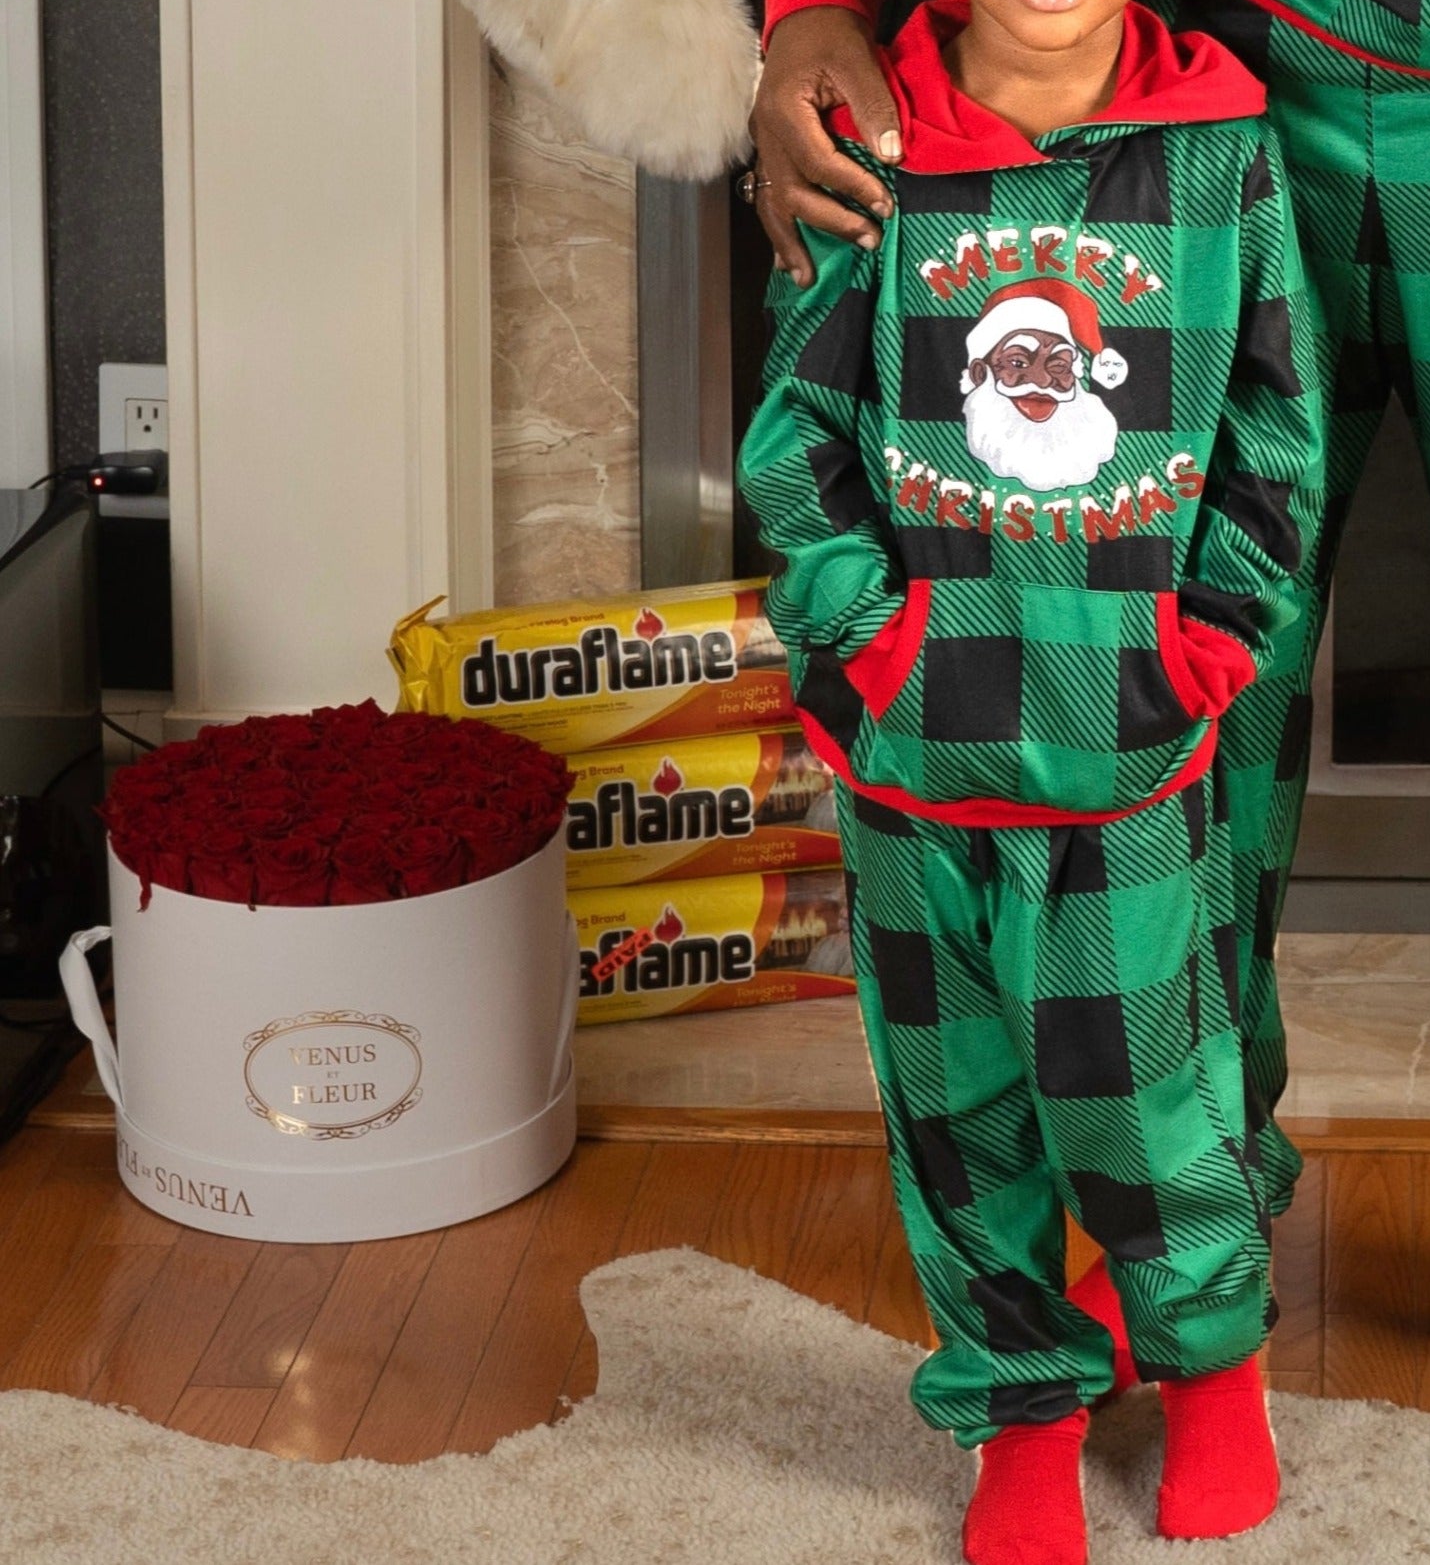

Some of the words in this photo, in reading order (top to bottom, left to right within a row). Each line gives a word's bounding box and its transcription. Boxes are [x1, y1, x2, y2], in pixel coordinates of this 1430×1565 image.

[920, 224, 1163, 305] MERRY
[461, 626, 736, 708] duraflame
[719, 683, 780, 701] Tonight's
[717, 701, 740, 715] the
[743, 698, 781, 714] Night
[588, 764, 625, 776] Brand
[590, 912, 626, 925] Brand
[288, 1043, 377, 1066] VENUS
[291, 1082, 377, 1105] FLEUR
[154, 1166, 255, 1218] VENUS
